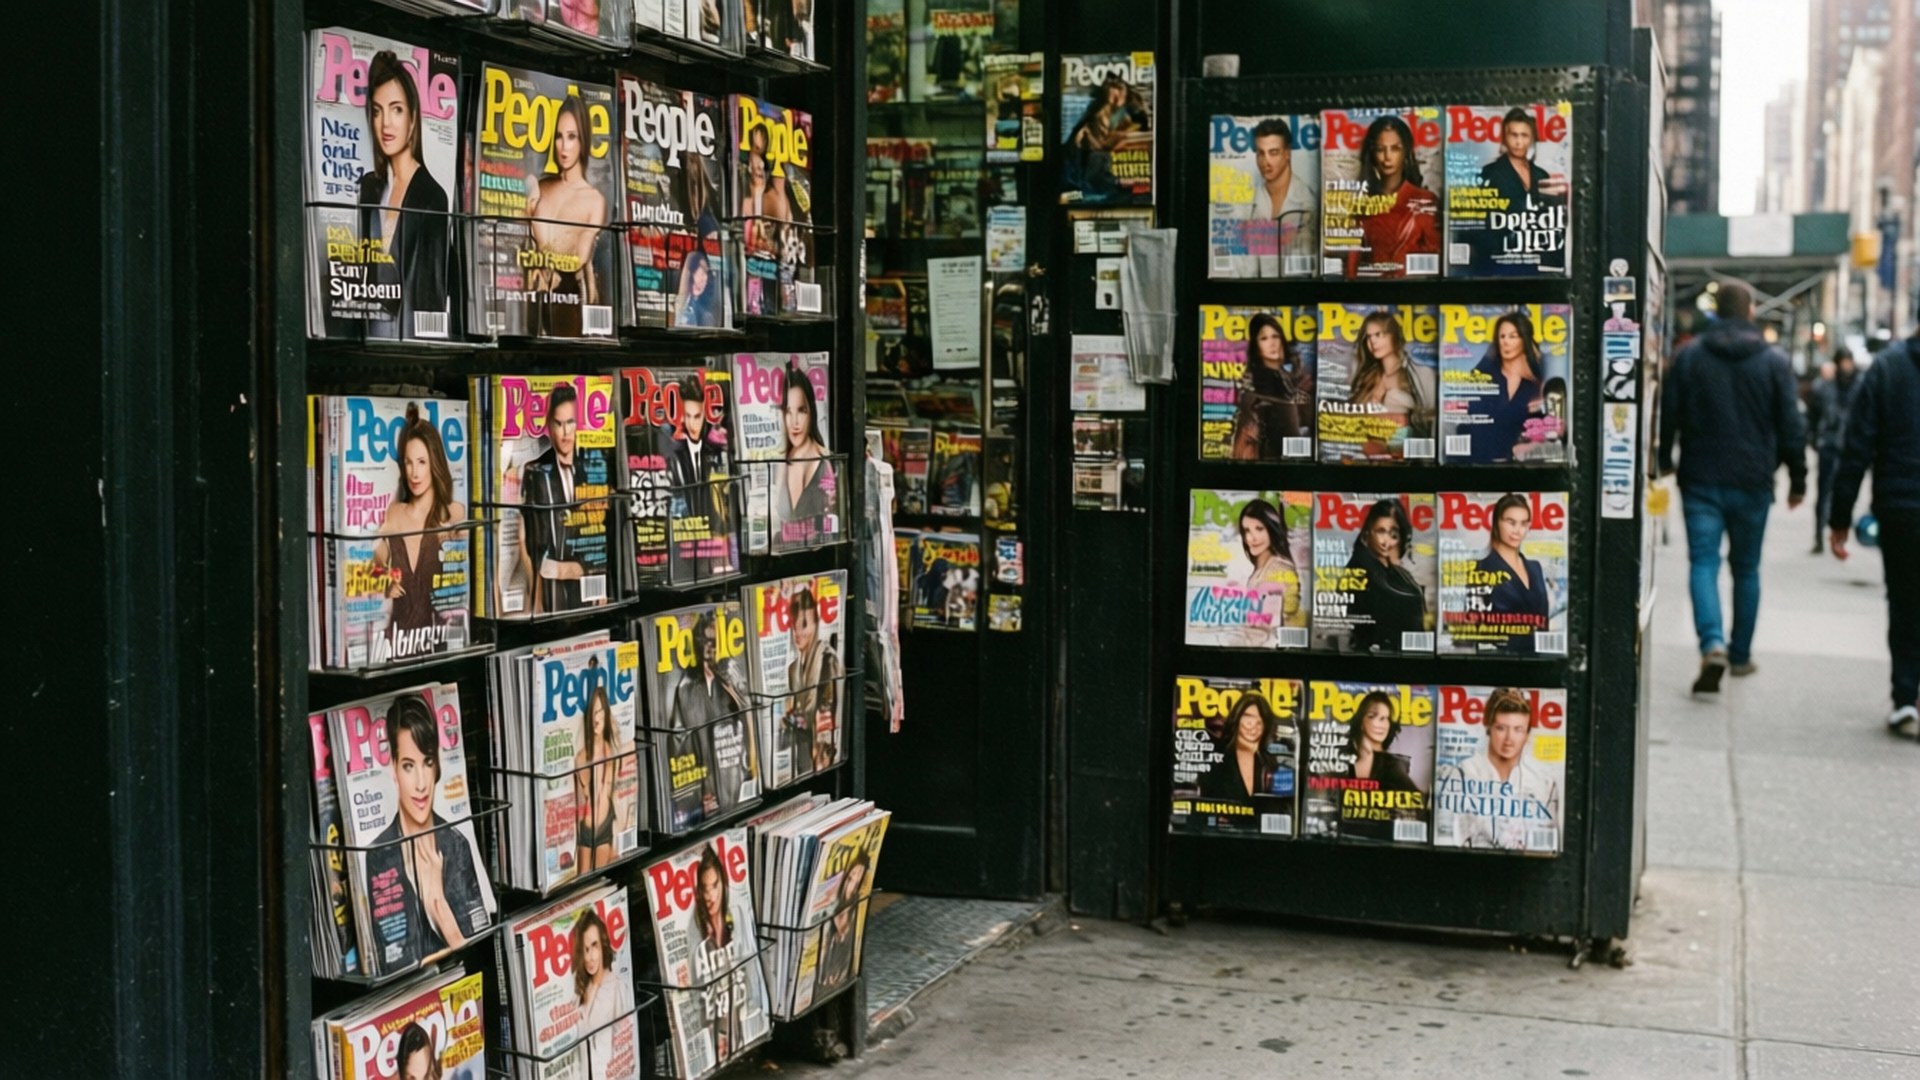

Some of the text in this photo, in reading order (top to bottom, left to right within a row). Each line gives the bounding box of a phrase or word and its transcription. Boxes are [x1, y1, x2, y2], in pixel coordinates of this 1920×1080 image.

[622, 79, 715, 168] People
[1323, 109, 1440, 150] Pele
[1446, 104, 1566, 143] Peole
[1439, 687, 1562, 730] Pele
